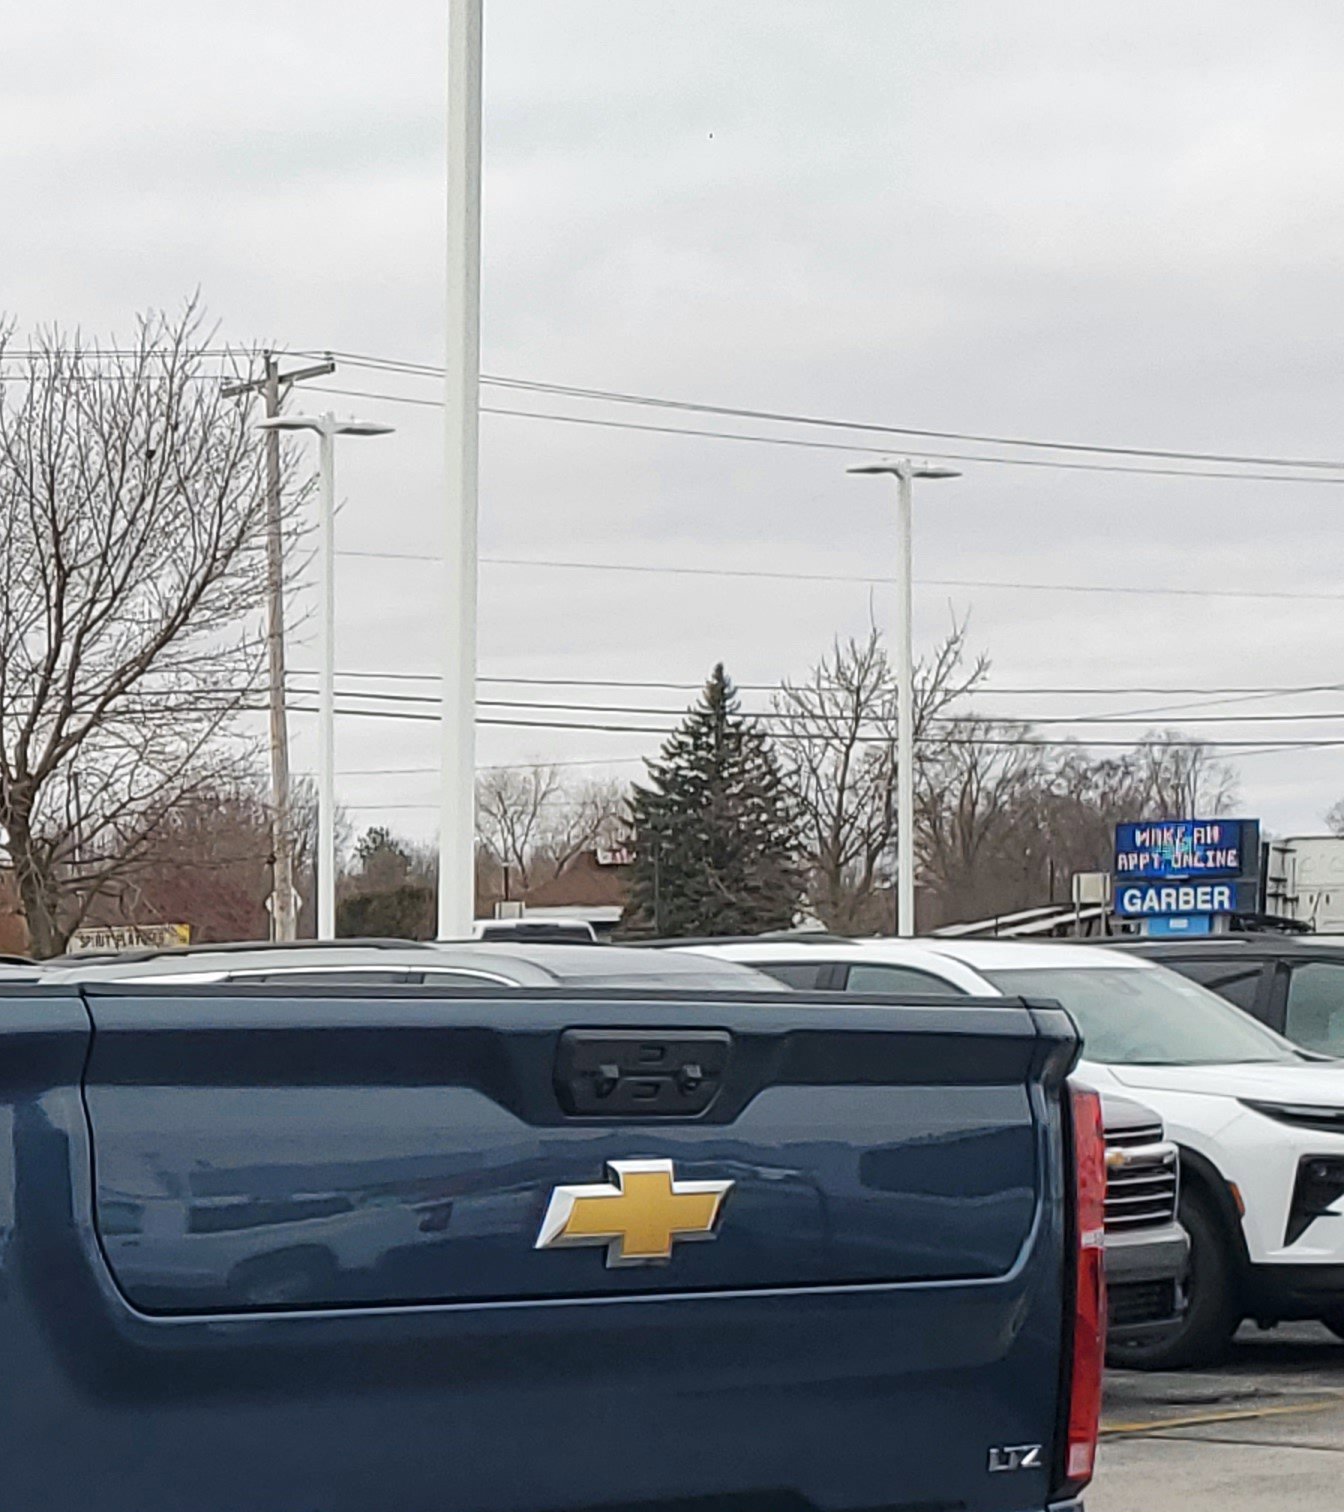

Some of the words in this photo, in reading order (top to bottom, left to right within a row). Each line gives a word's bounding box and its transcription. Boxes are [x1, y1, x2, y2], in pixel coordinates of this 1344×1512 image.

[1194, 824, 1220, 845] AN
[1172, 848, 1238, 869] ONLINE
[1123, 885, 1230, 912] GARBER
[989, 1444, 1042, 1472] LTZ
